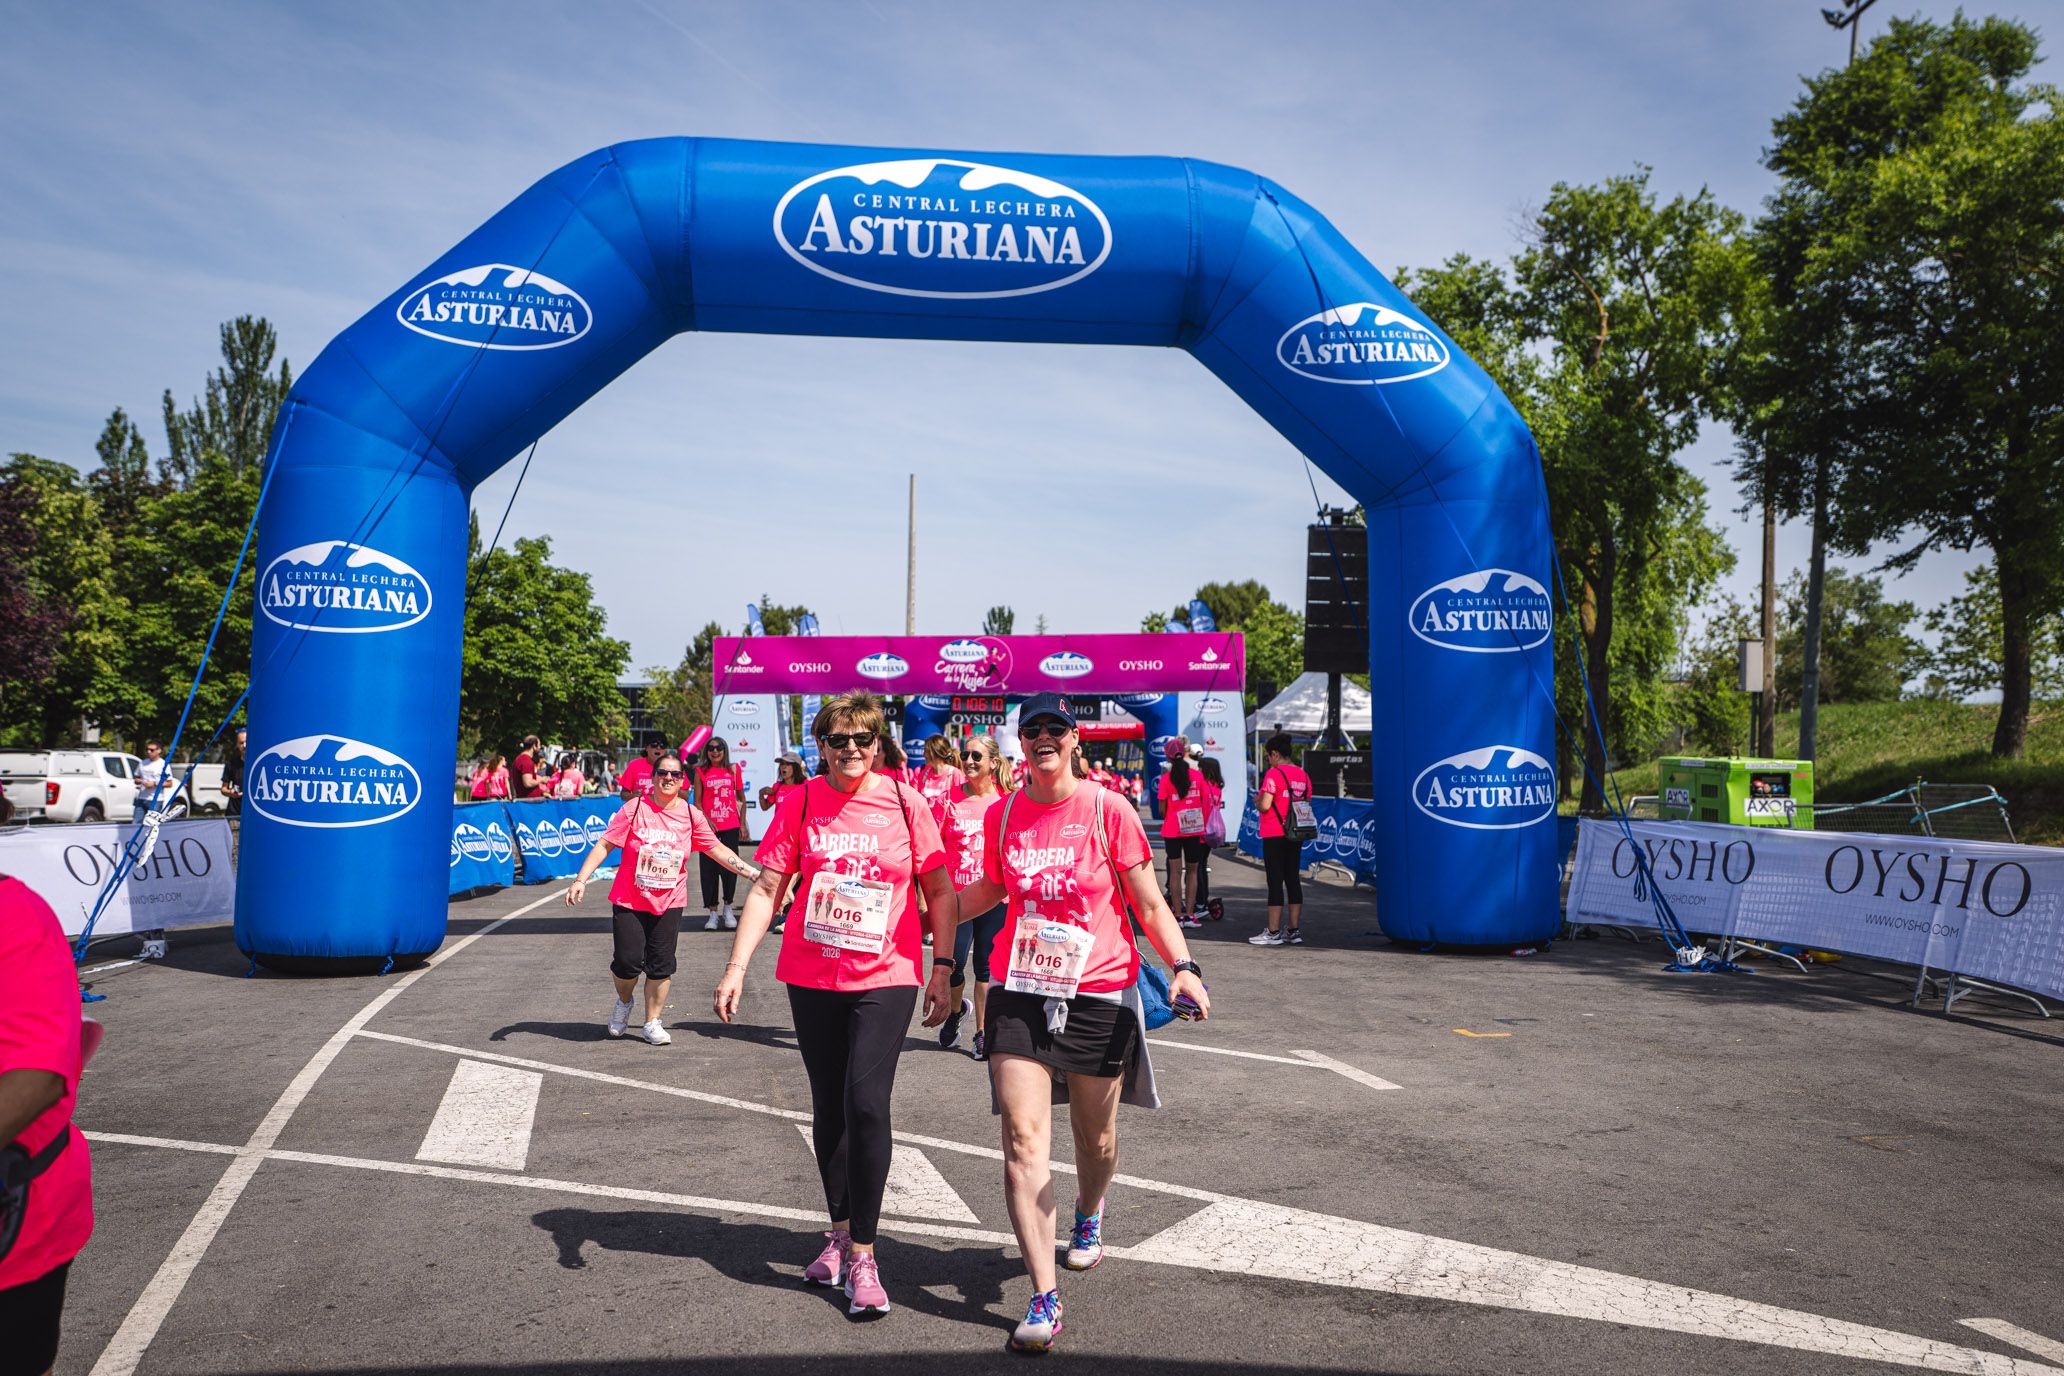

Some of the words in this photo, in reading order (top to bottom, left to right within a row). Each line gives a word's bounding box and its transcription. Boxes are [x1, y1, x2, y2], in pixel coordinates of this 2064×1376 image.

[852, 193, 960, 213] CENTRAL
[970, 199, 1078, 219] LECHERA
[799, 193, 1087, 266] ASTURIANA
[441, 289, 502, 301] CENTRAL
[508, 293, 573, 309] LECHERA
[407, 293, 577, 335] ASTURIANA
[1319, 329, 1378, 340] CENTRAL
[1381, 329, 1431, 342] LECHERA
[1290, 333, 1442, 365] ASTURIANA
[286, 570, 346, 582] CENTRAL
[352, 573, 416, 588] LECHERA
[265, 573, 420, 615] ASTURIANA
[1447, 597, 1504, 607] CENTRAL
[1420, 600, 1550, 632] ASTURIANA
[724, 664, 765, 674] Santander
[788, 662, 832, 673] OYSHO
[860, 662, 906, 673] ASTURIANA
[934, 660, 976, 674] Carrera
[1043, 659, 1090, 672] ASTURIANA
[1118, 659, 1164, 672] OYSHO
[1187, 661, 1231, 671] Santander
[957, 674, 991, 692] Mujer
[727, 722, 761, 731] OYSHO
[951, 713, 1005, 725] OYSHO
[1193, 720, 1229, 729] OYSHO
[274, 765, 334, 776] CENTRAL
[340, 767, 404, 779] LECHERA
[1451, 774, 1508, 783] CENTRAL
[253, 766, 409, 806] ASTURIANA
[1424, 776, 1553, 808] ASTURIANA
[1746, 799, 1796, 814] AXOR
[953, 819, 984, 832] CARRE
[1009, 829, 1038, 840] OYSHO
[810, 831, 880, 854] CARRERA
[1009, 846, 1076, 868] CARRERA
[1611, 837, 1756, 885] OYSHO
[651, 865, 668, 875] 016
[1041, 873, 1065, 901] DE
[1824, 845, 2032, 918] OYSHO
[837, 885, 867, 896] ASTURIANA
[833, 907, 863, 923] 016
[1864, 912, 1960, 939] WWW.OYSHO.COM
[1035, 954, 1062, 969] 016
